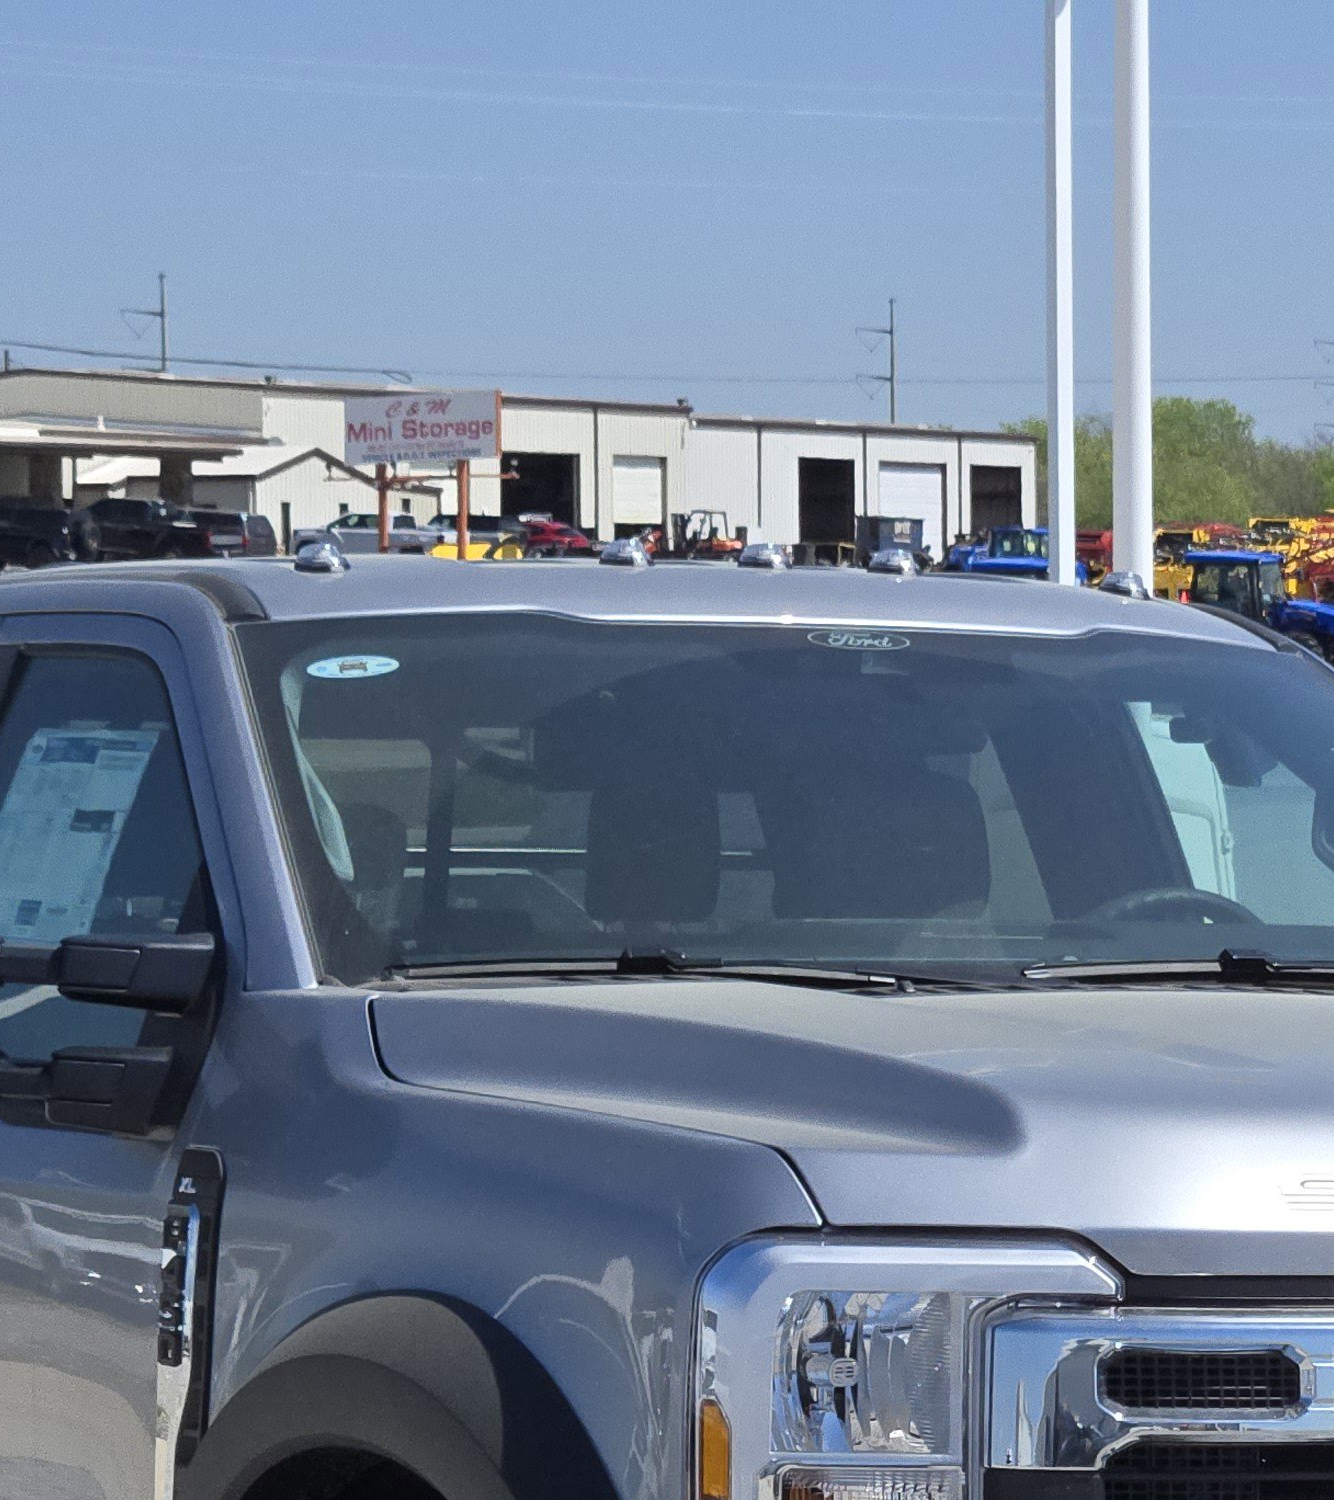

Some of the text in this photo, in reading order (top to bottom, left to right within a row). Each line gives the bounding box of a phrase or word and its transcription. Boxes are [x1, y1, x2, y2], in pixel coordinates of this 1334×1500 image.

[347, 418, 493, 443] Mini Storage
[827, 629, 894, 649] Ford
